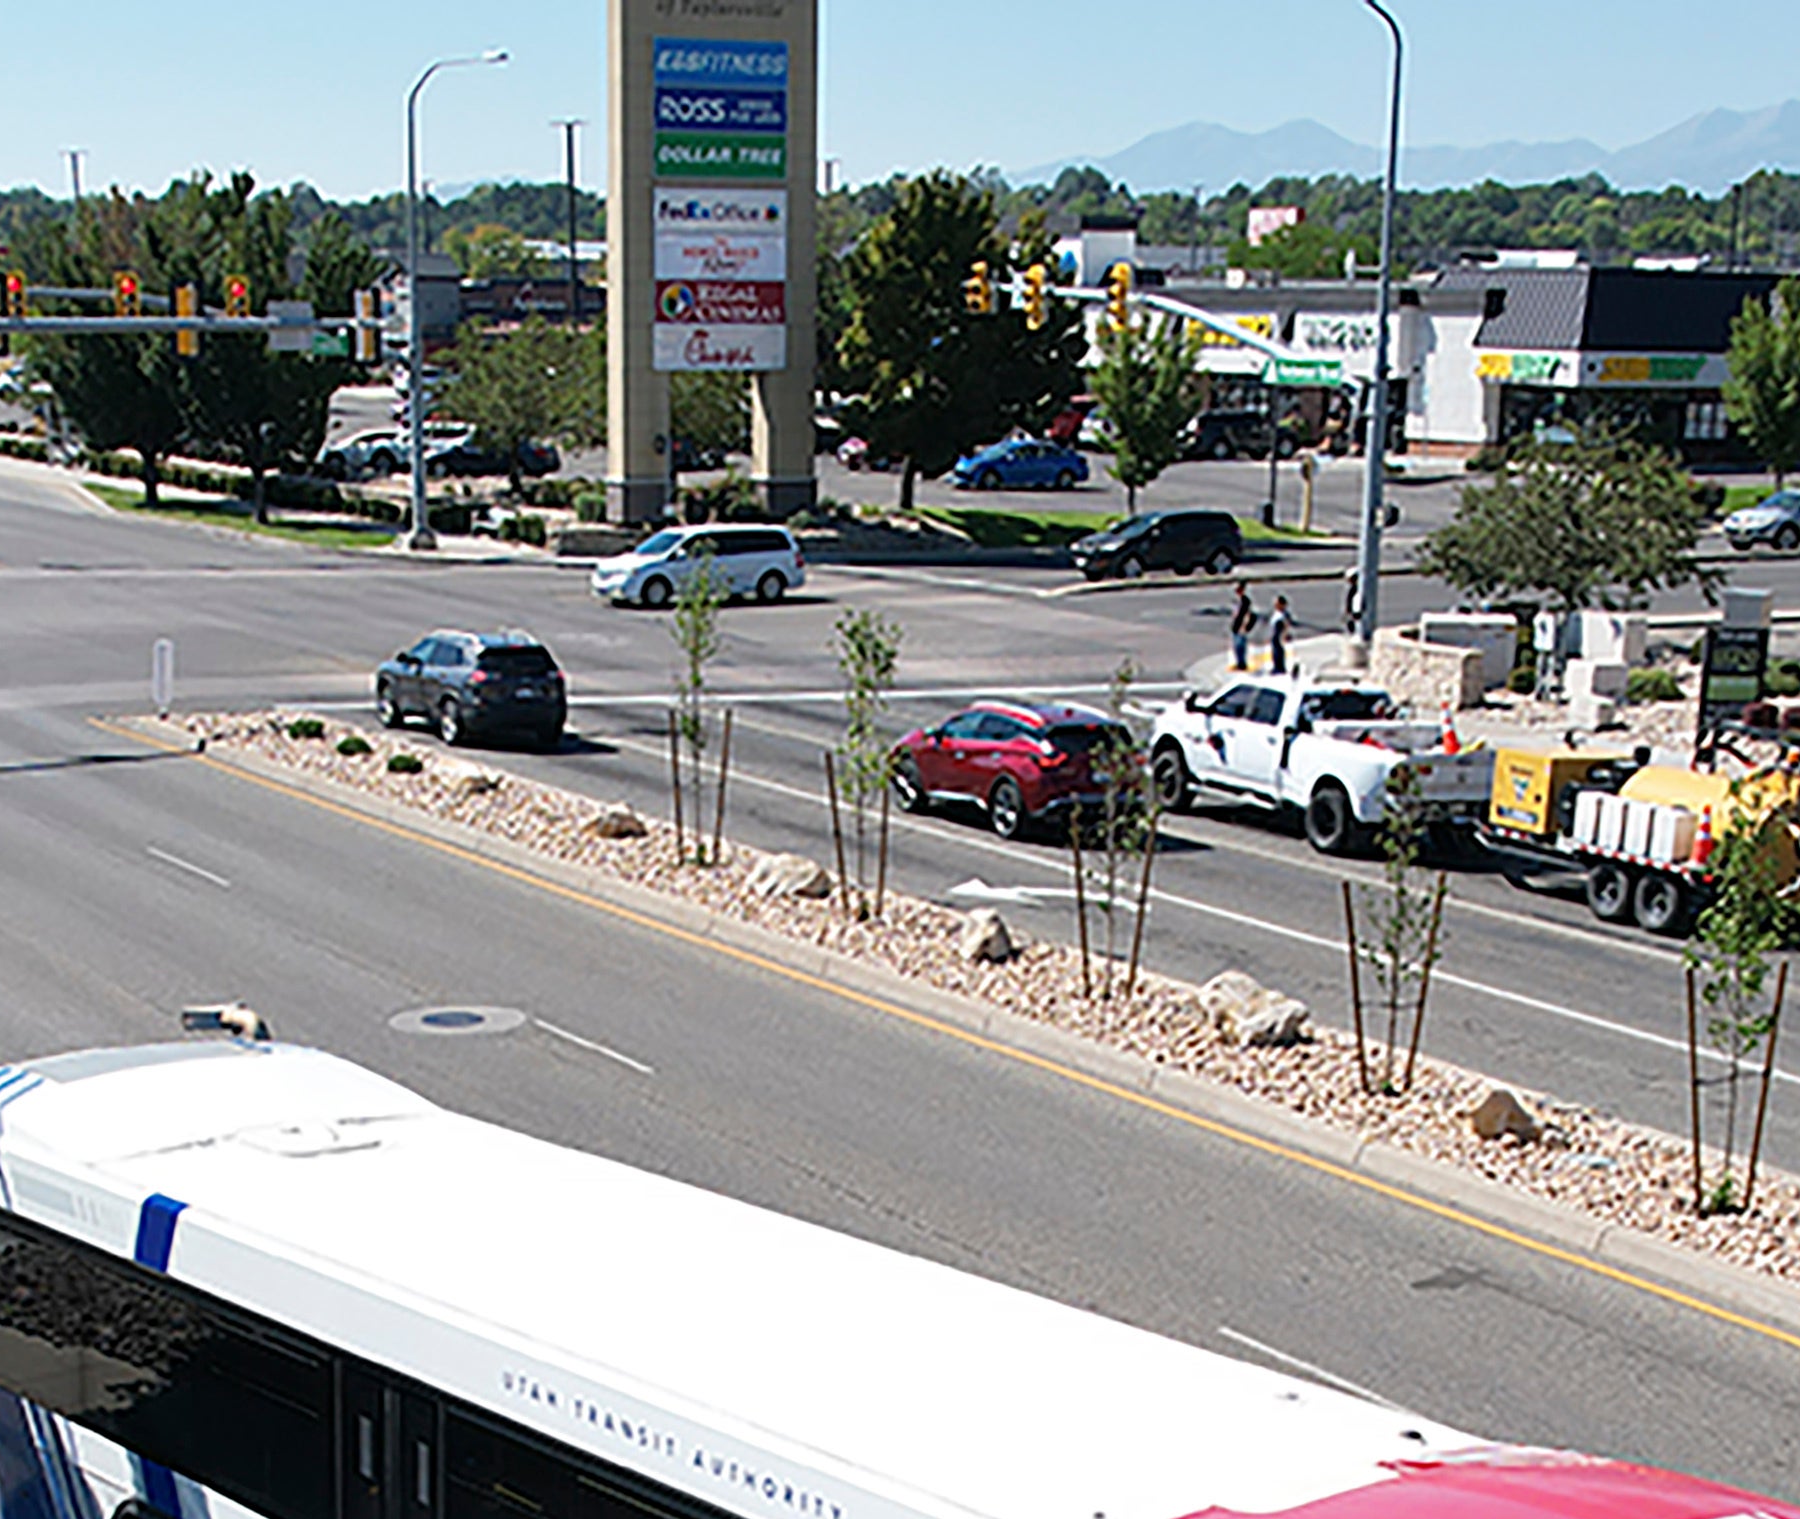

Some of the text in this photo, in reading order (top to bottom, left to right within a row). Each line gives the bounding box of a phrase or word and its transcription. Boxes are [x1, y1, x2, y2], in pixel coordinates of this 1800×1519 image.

[660, 96, 726, 122] ROSS
[503, 1371, 558, 1406] UTAH
[573, 1400, 676, 1457] TRANSIT
